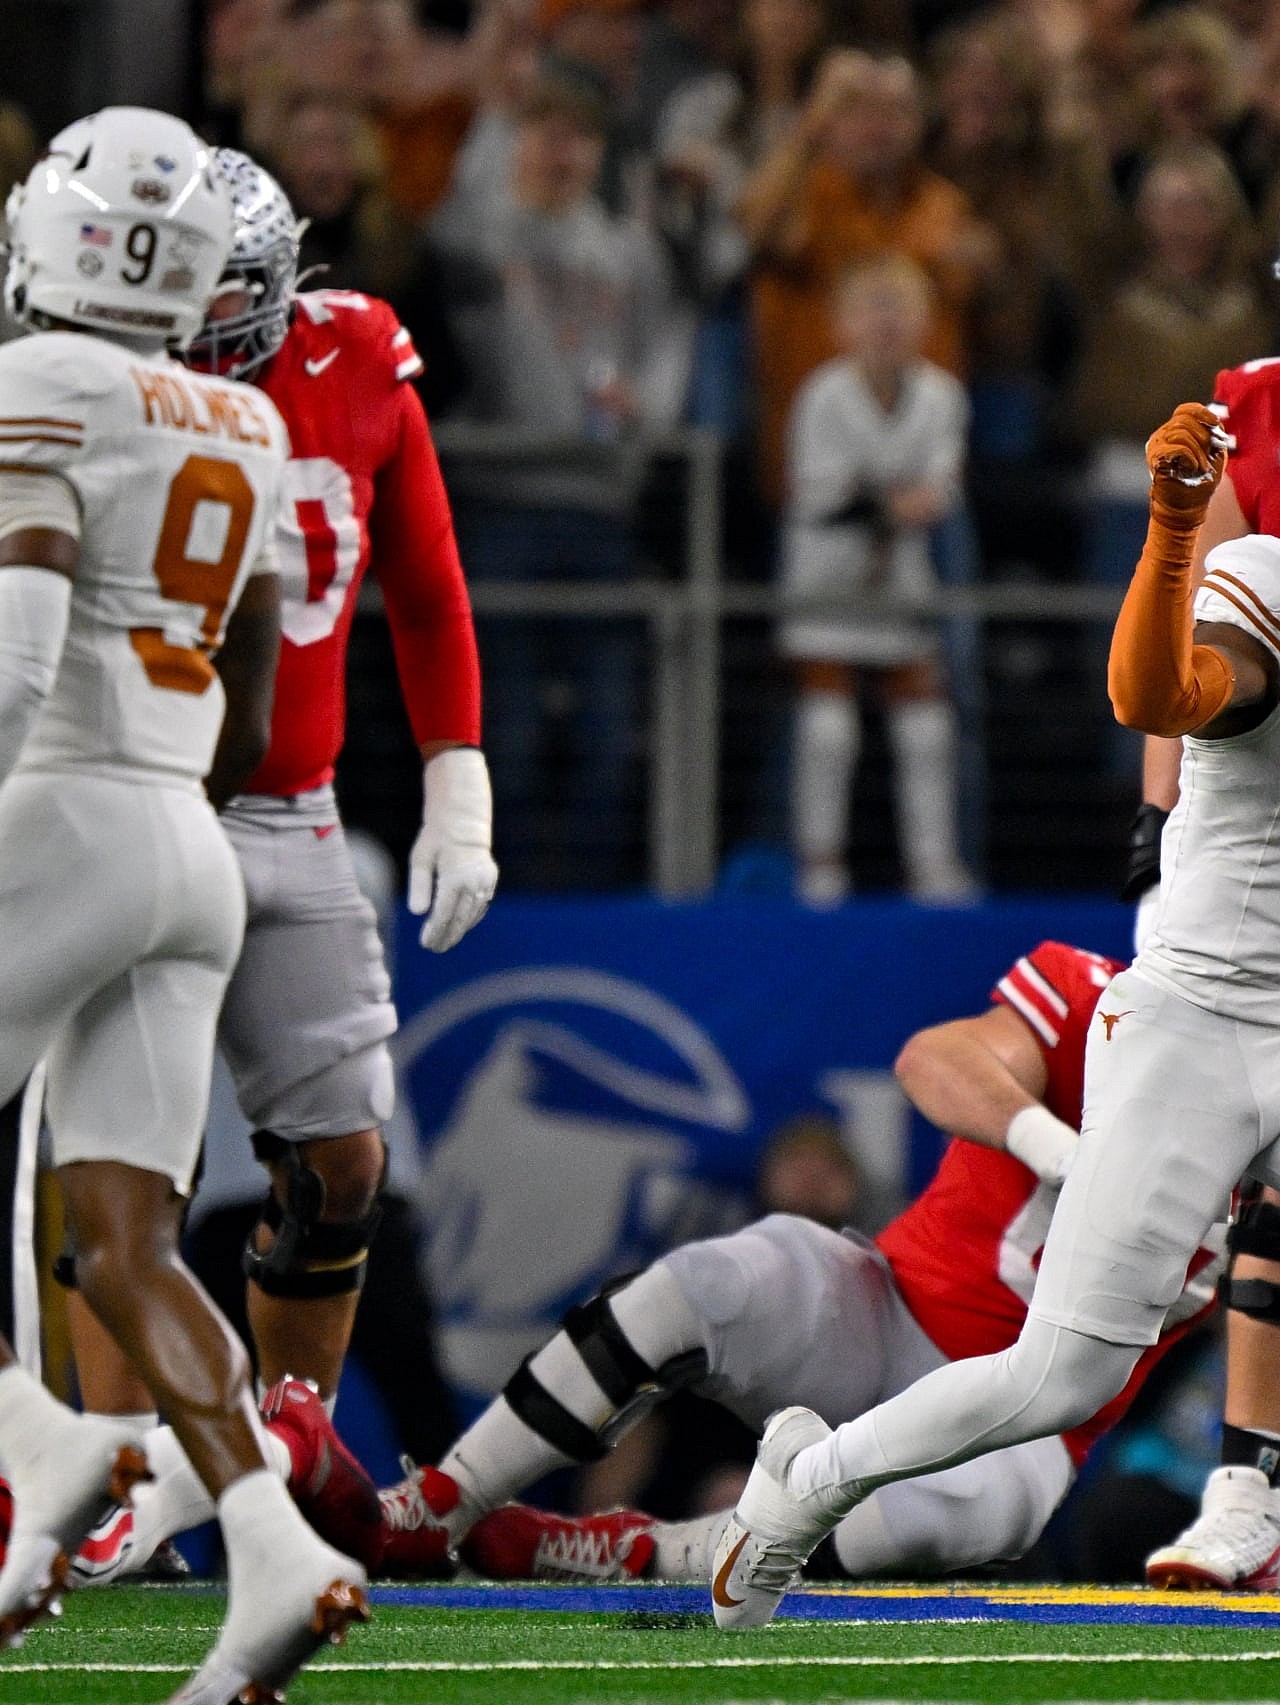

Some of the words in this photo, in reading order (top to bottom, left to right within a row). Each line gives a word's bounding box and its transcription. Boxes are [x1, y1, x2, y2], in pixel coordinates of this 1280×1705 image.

[120, 221, 159, 287] 9
[129, 366, 273, 449] HOLMES
[128, 454, 256, 696] 9
